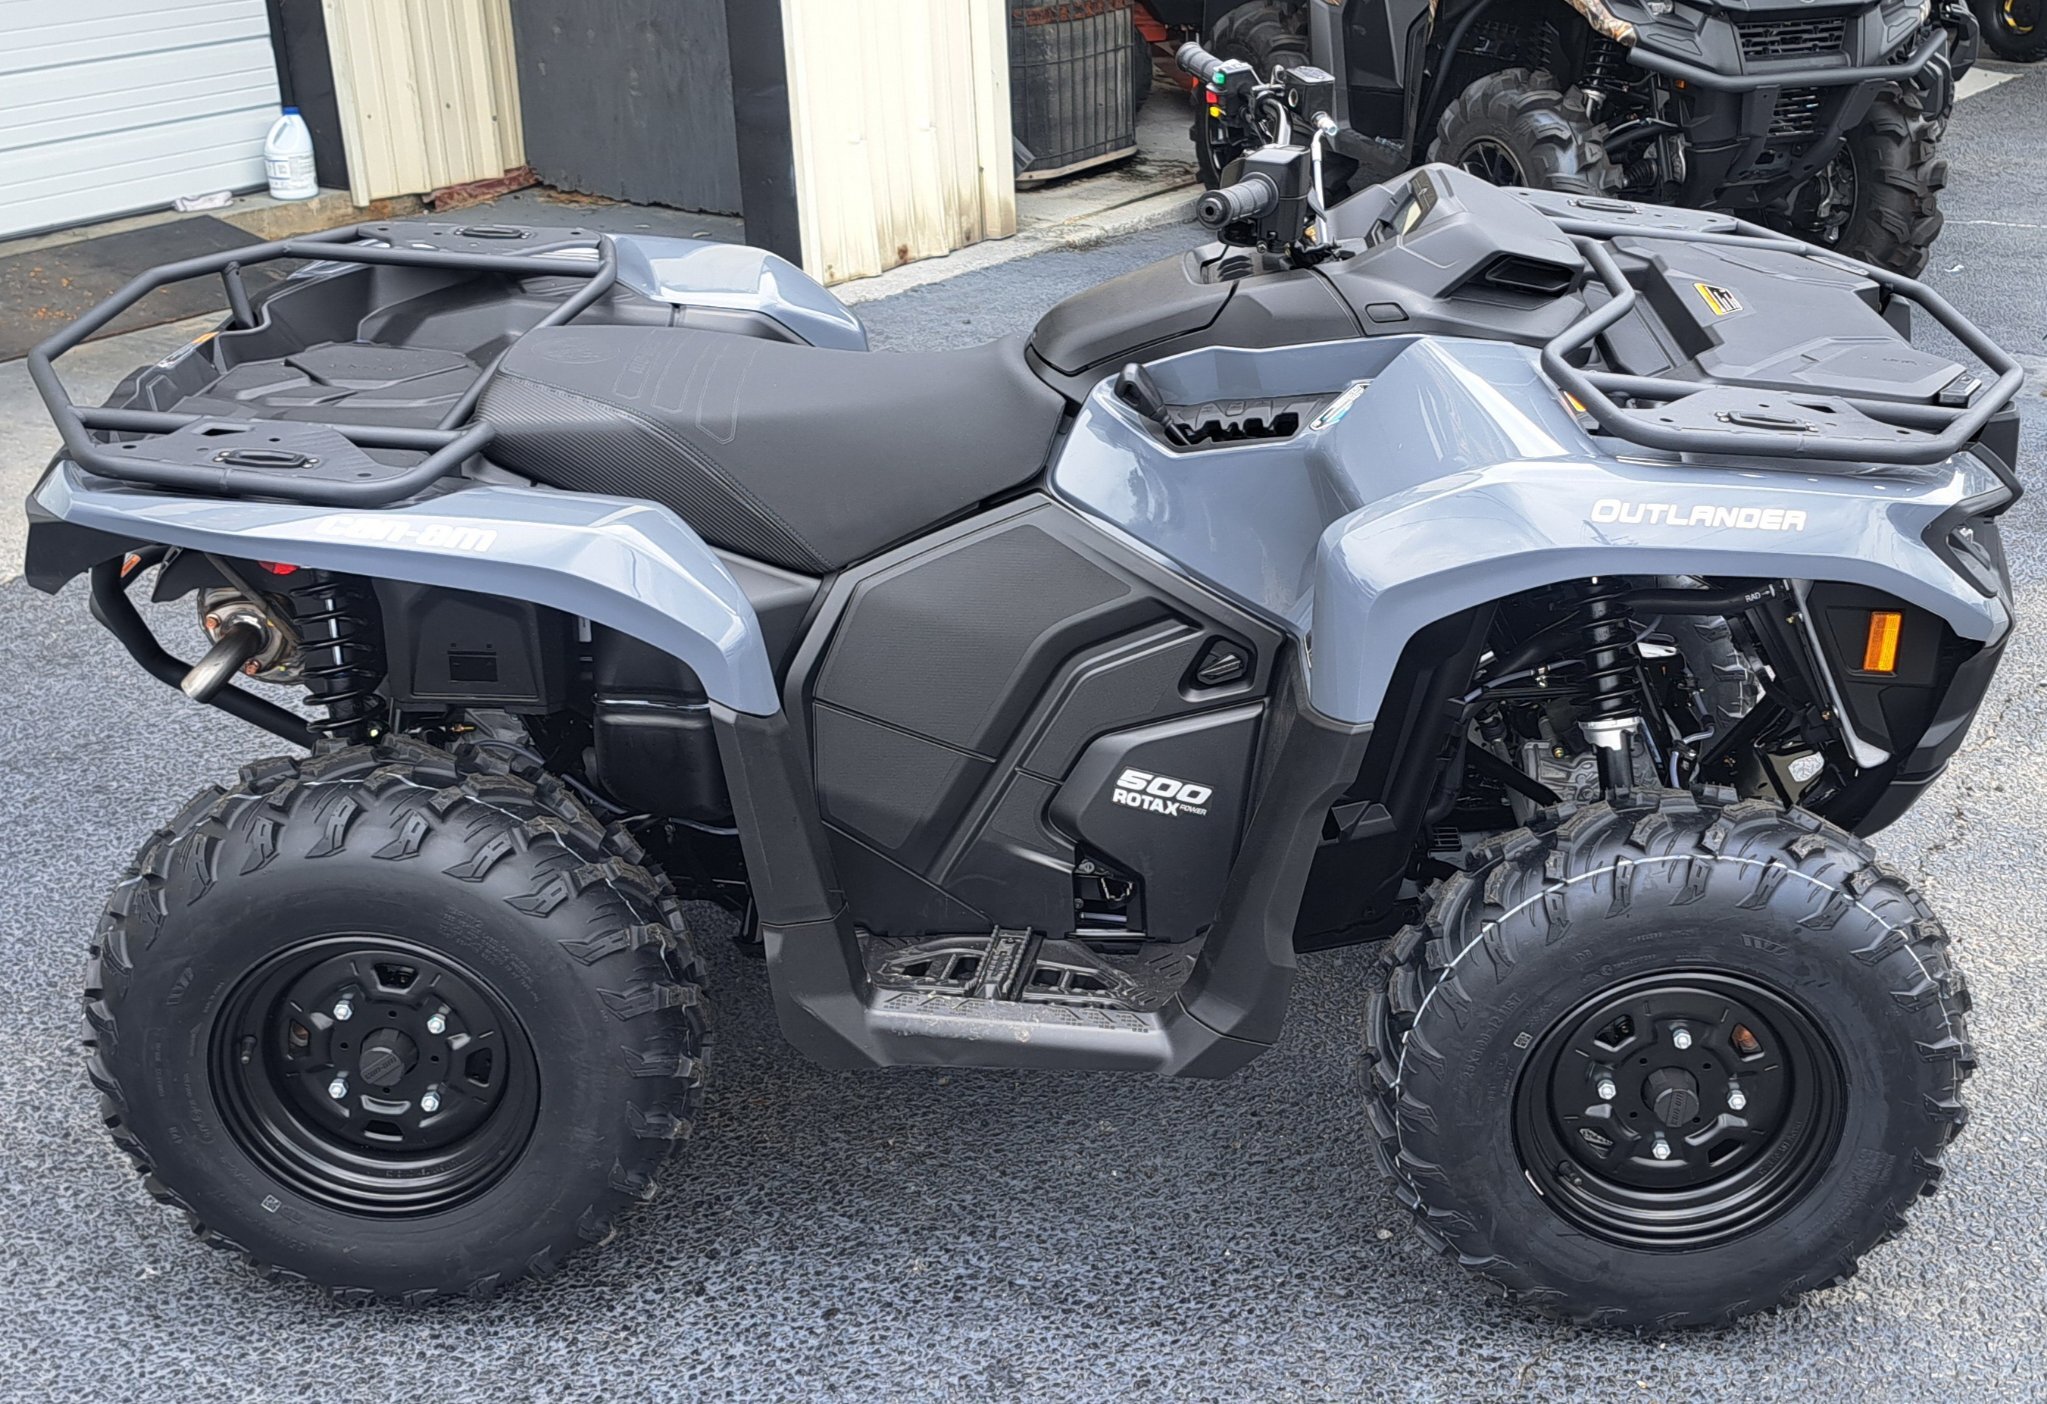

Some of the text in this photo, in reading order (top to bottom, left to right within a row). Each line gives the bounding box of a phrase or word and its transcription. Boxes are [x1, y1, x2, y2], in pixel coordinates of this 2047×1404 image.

[1590, 498, 1808, 532] OUTLANDER
[1744, 591, 1761, 602] RAD
[1112, 787, 1208, 817] ROTAX POWER
[1116, 768, 1213, 805] 500
